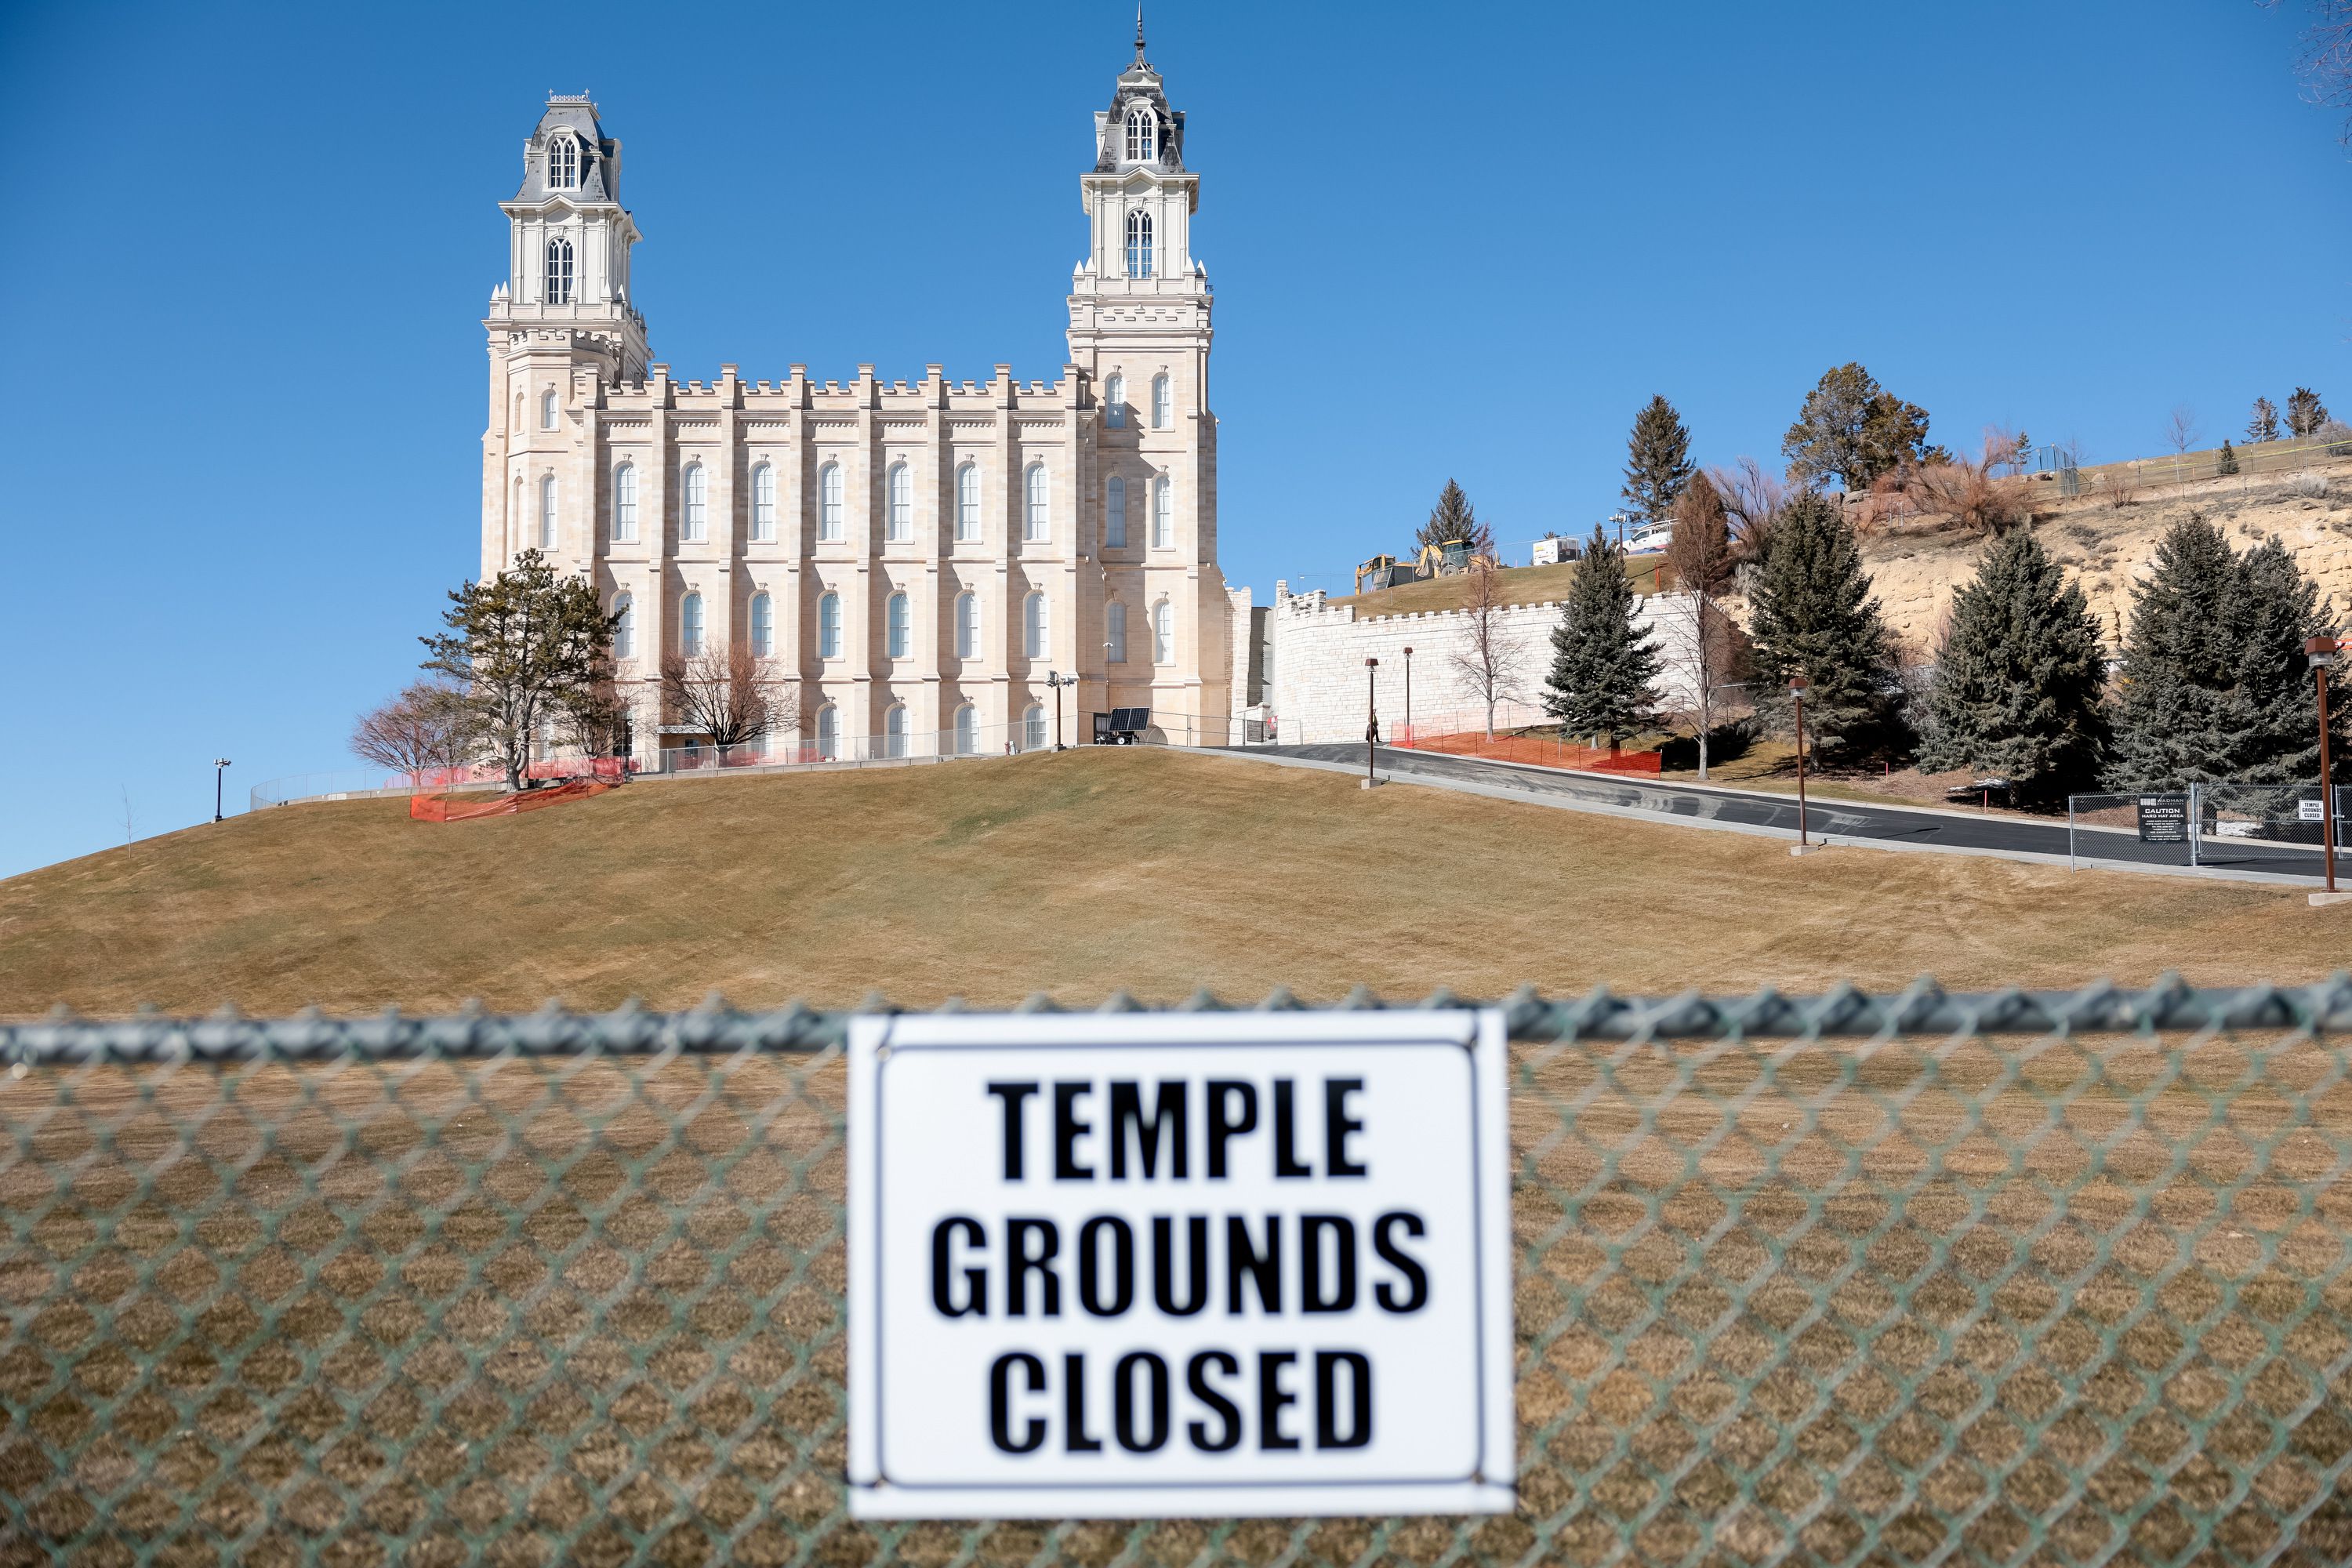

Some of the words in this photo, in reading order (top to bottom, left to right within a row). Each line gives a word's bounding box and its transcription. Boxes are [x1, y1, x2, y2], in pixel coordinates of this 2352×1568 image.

[987, 1077, 1367, 1181] TEMPLE
[930, 1211, 1429, 1320] GROUNDS
[989, 1350, 1374, 1455] CLOSED
